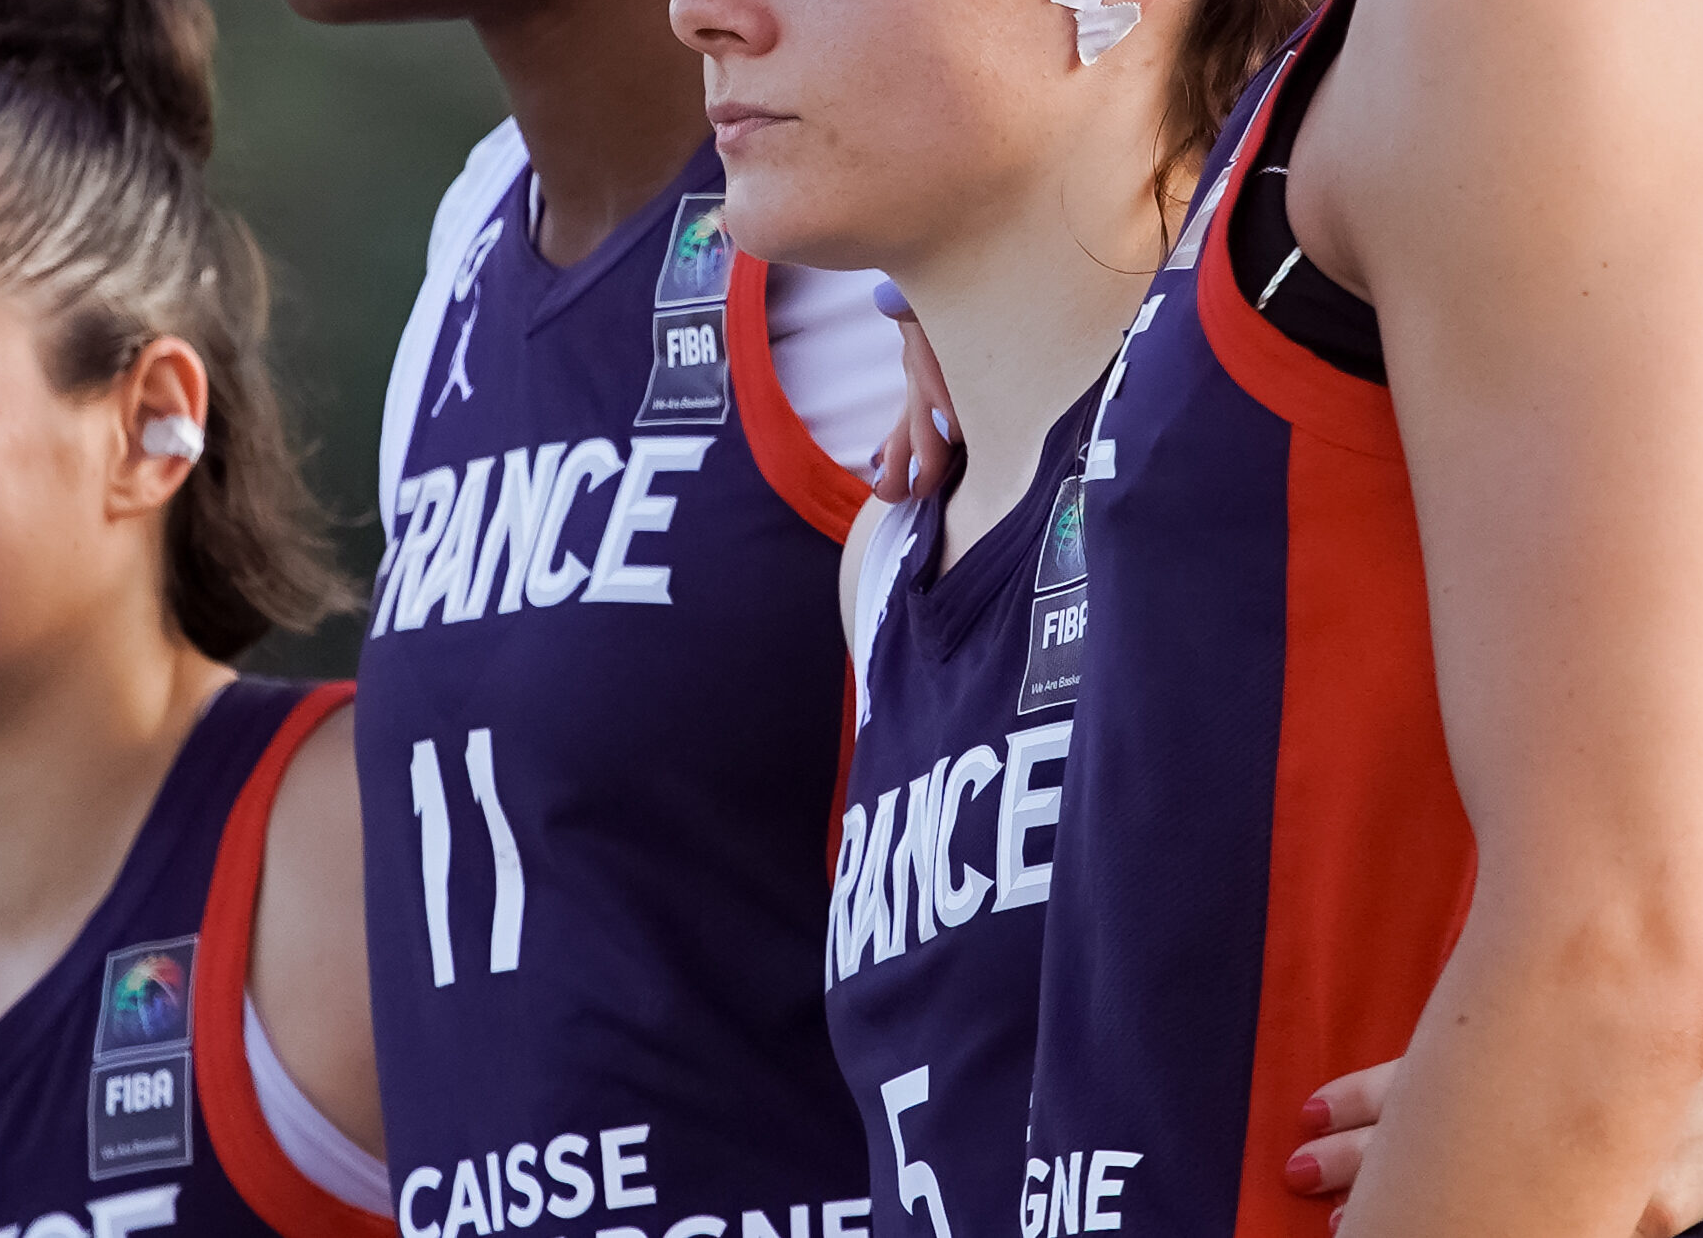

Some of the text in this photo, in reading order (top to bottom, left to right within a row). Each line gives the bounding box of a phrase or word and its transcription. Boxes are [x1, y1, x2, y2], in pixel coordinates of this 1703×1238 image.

[666, 324, 718, 368] FIBA
[410, 728, 525, 988] 11
[105, 1067, 174, 1117] FIBA
[399, 1124, 658, 1238] CAISSE
[880, 1064, 953, 1238] 5
